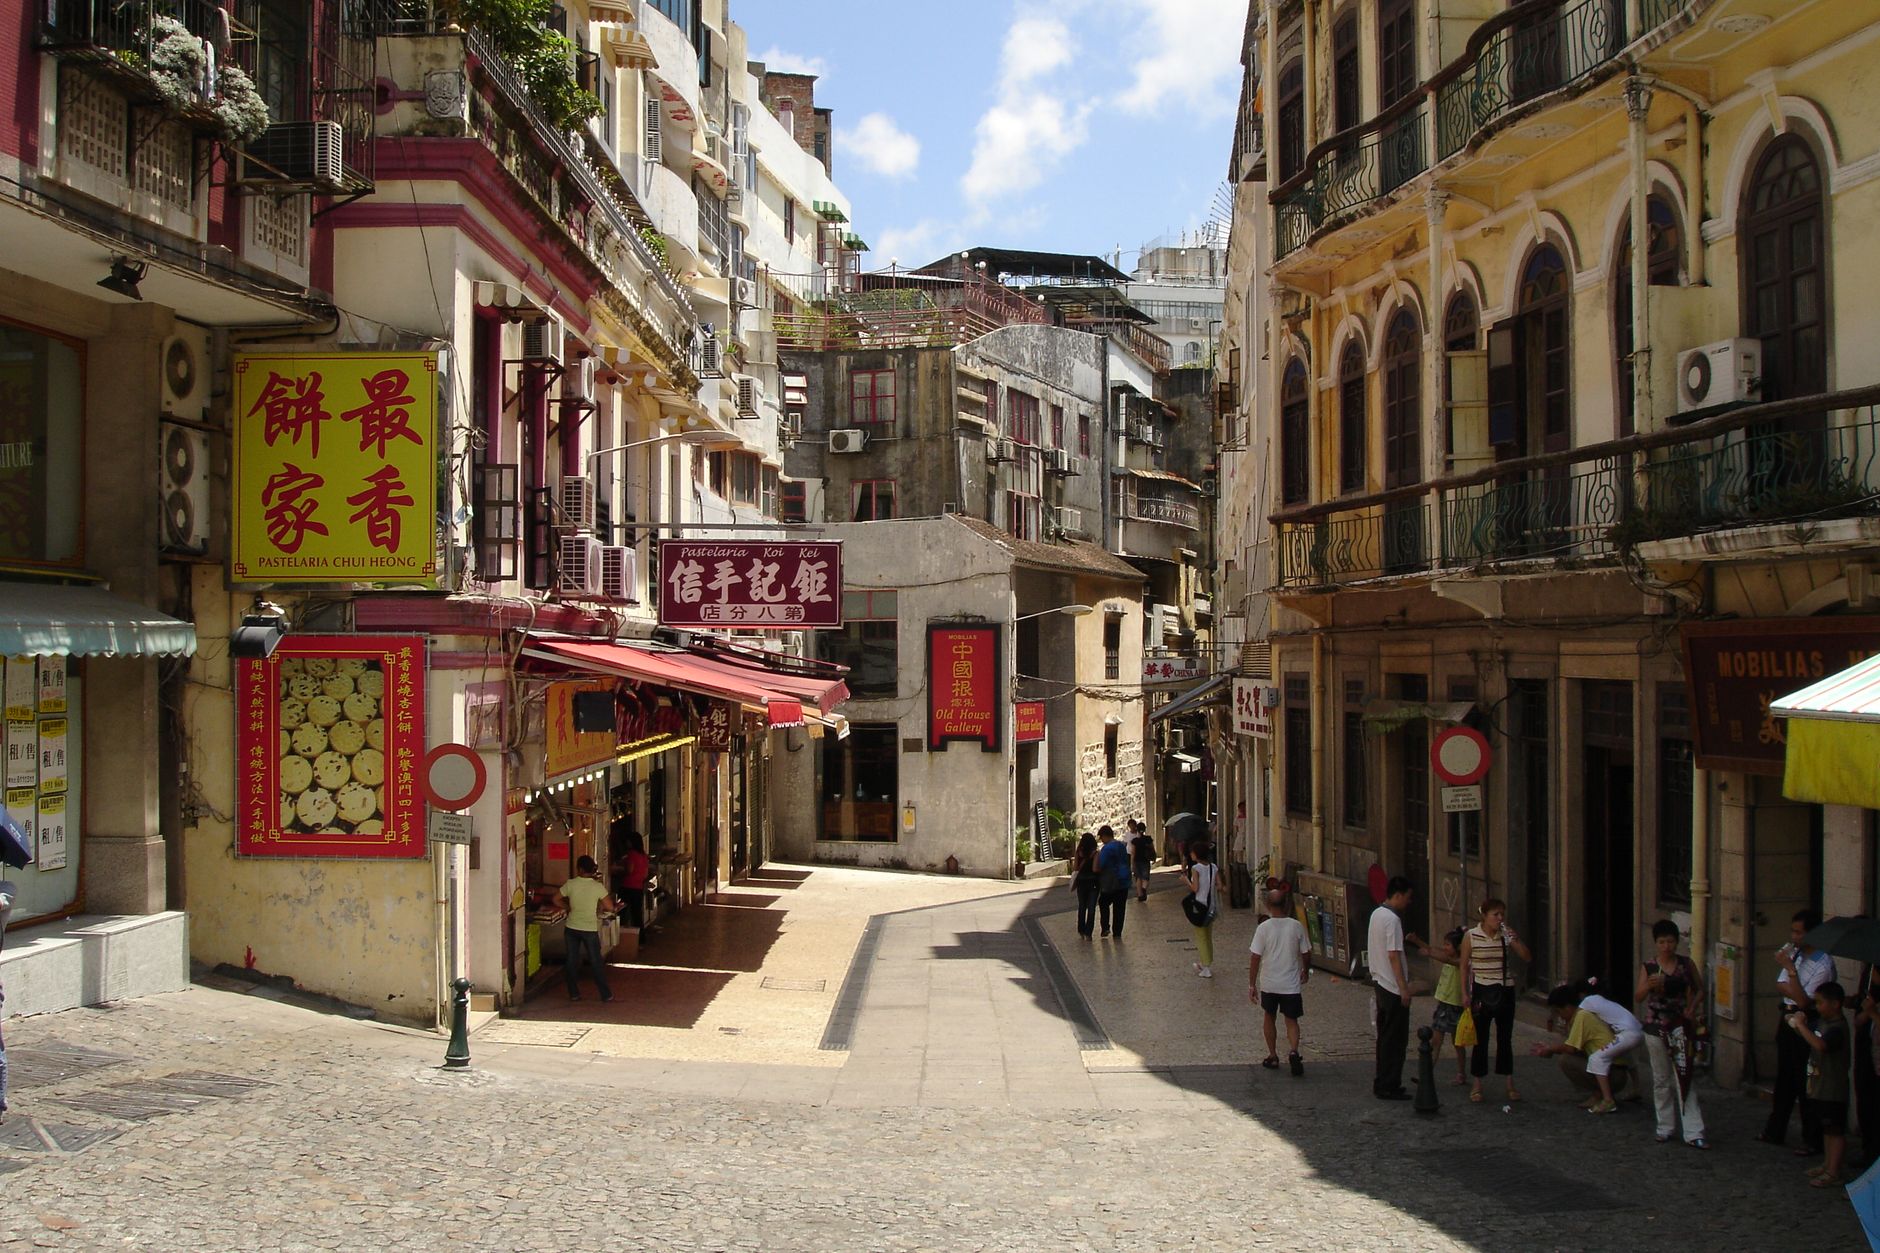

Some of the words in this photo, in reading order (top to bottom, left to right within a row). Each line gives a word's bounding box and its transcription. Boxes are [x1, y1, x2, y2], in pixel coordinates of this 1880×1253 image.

[0, 442, 33, 468] ITURE
[681, 546, 749, 558] Pastelaria
[763, 547, 784, 558] Koi
[799, 547, 821, 558] Kei
[258, 556, 329, 568] PASTELARIA
[332, 556, 365, 568] CHUI
[369, 556, 416, 568] HEONG
[1718, 650, 1825, 678] MOBILIAS
[935, 708, 954, 720] Old
[959, 709, 991, 720] House
[944, 721, 982, 735] Gallery
